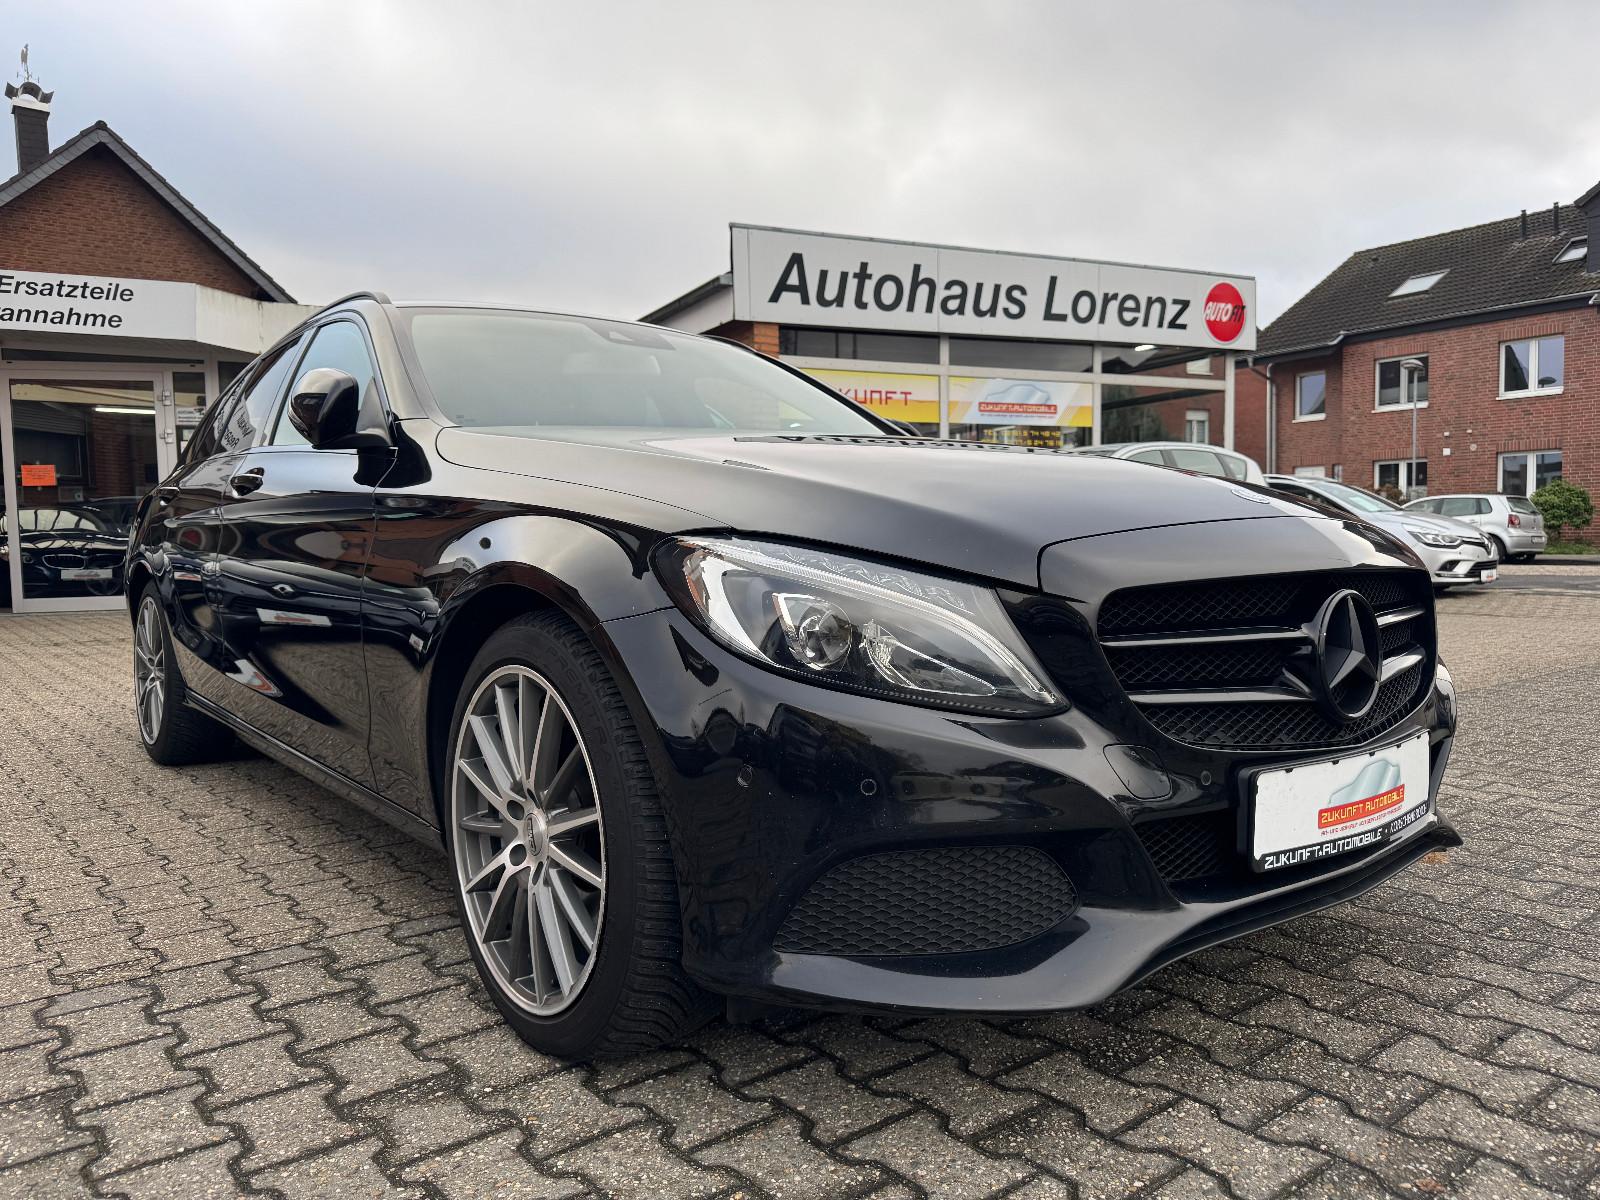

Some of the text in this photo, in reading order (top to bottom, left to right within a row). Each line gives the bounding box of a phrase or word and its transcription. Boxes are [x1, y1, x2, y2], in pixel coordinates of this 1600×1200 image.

[0, 275, 134, 302] Ersatzteile
[768, 252, 1191, 331] Autohaus Lorenz
[0, 305, 123, 329] annahme
[1321, 803, 1364, 824] ZUKUNFT
[1365, 787, 1404, 812] AUTOMOBILE
